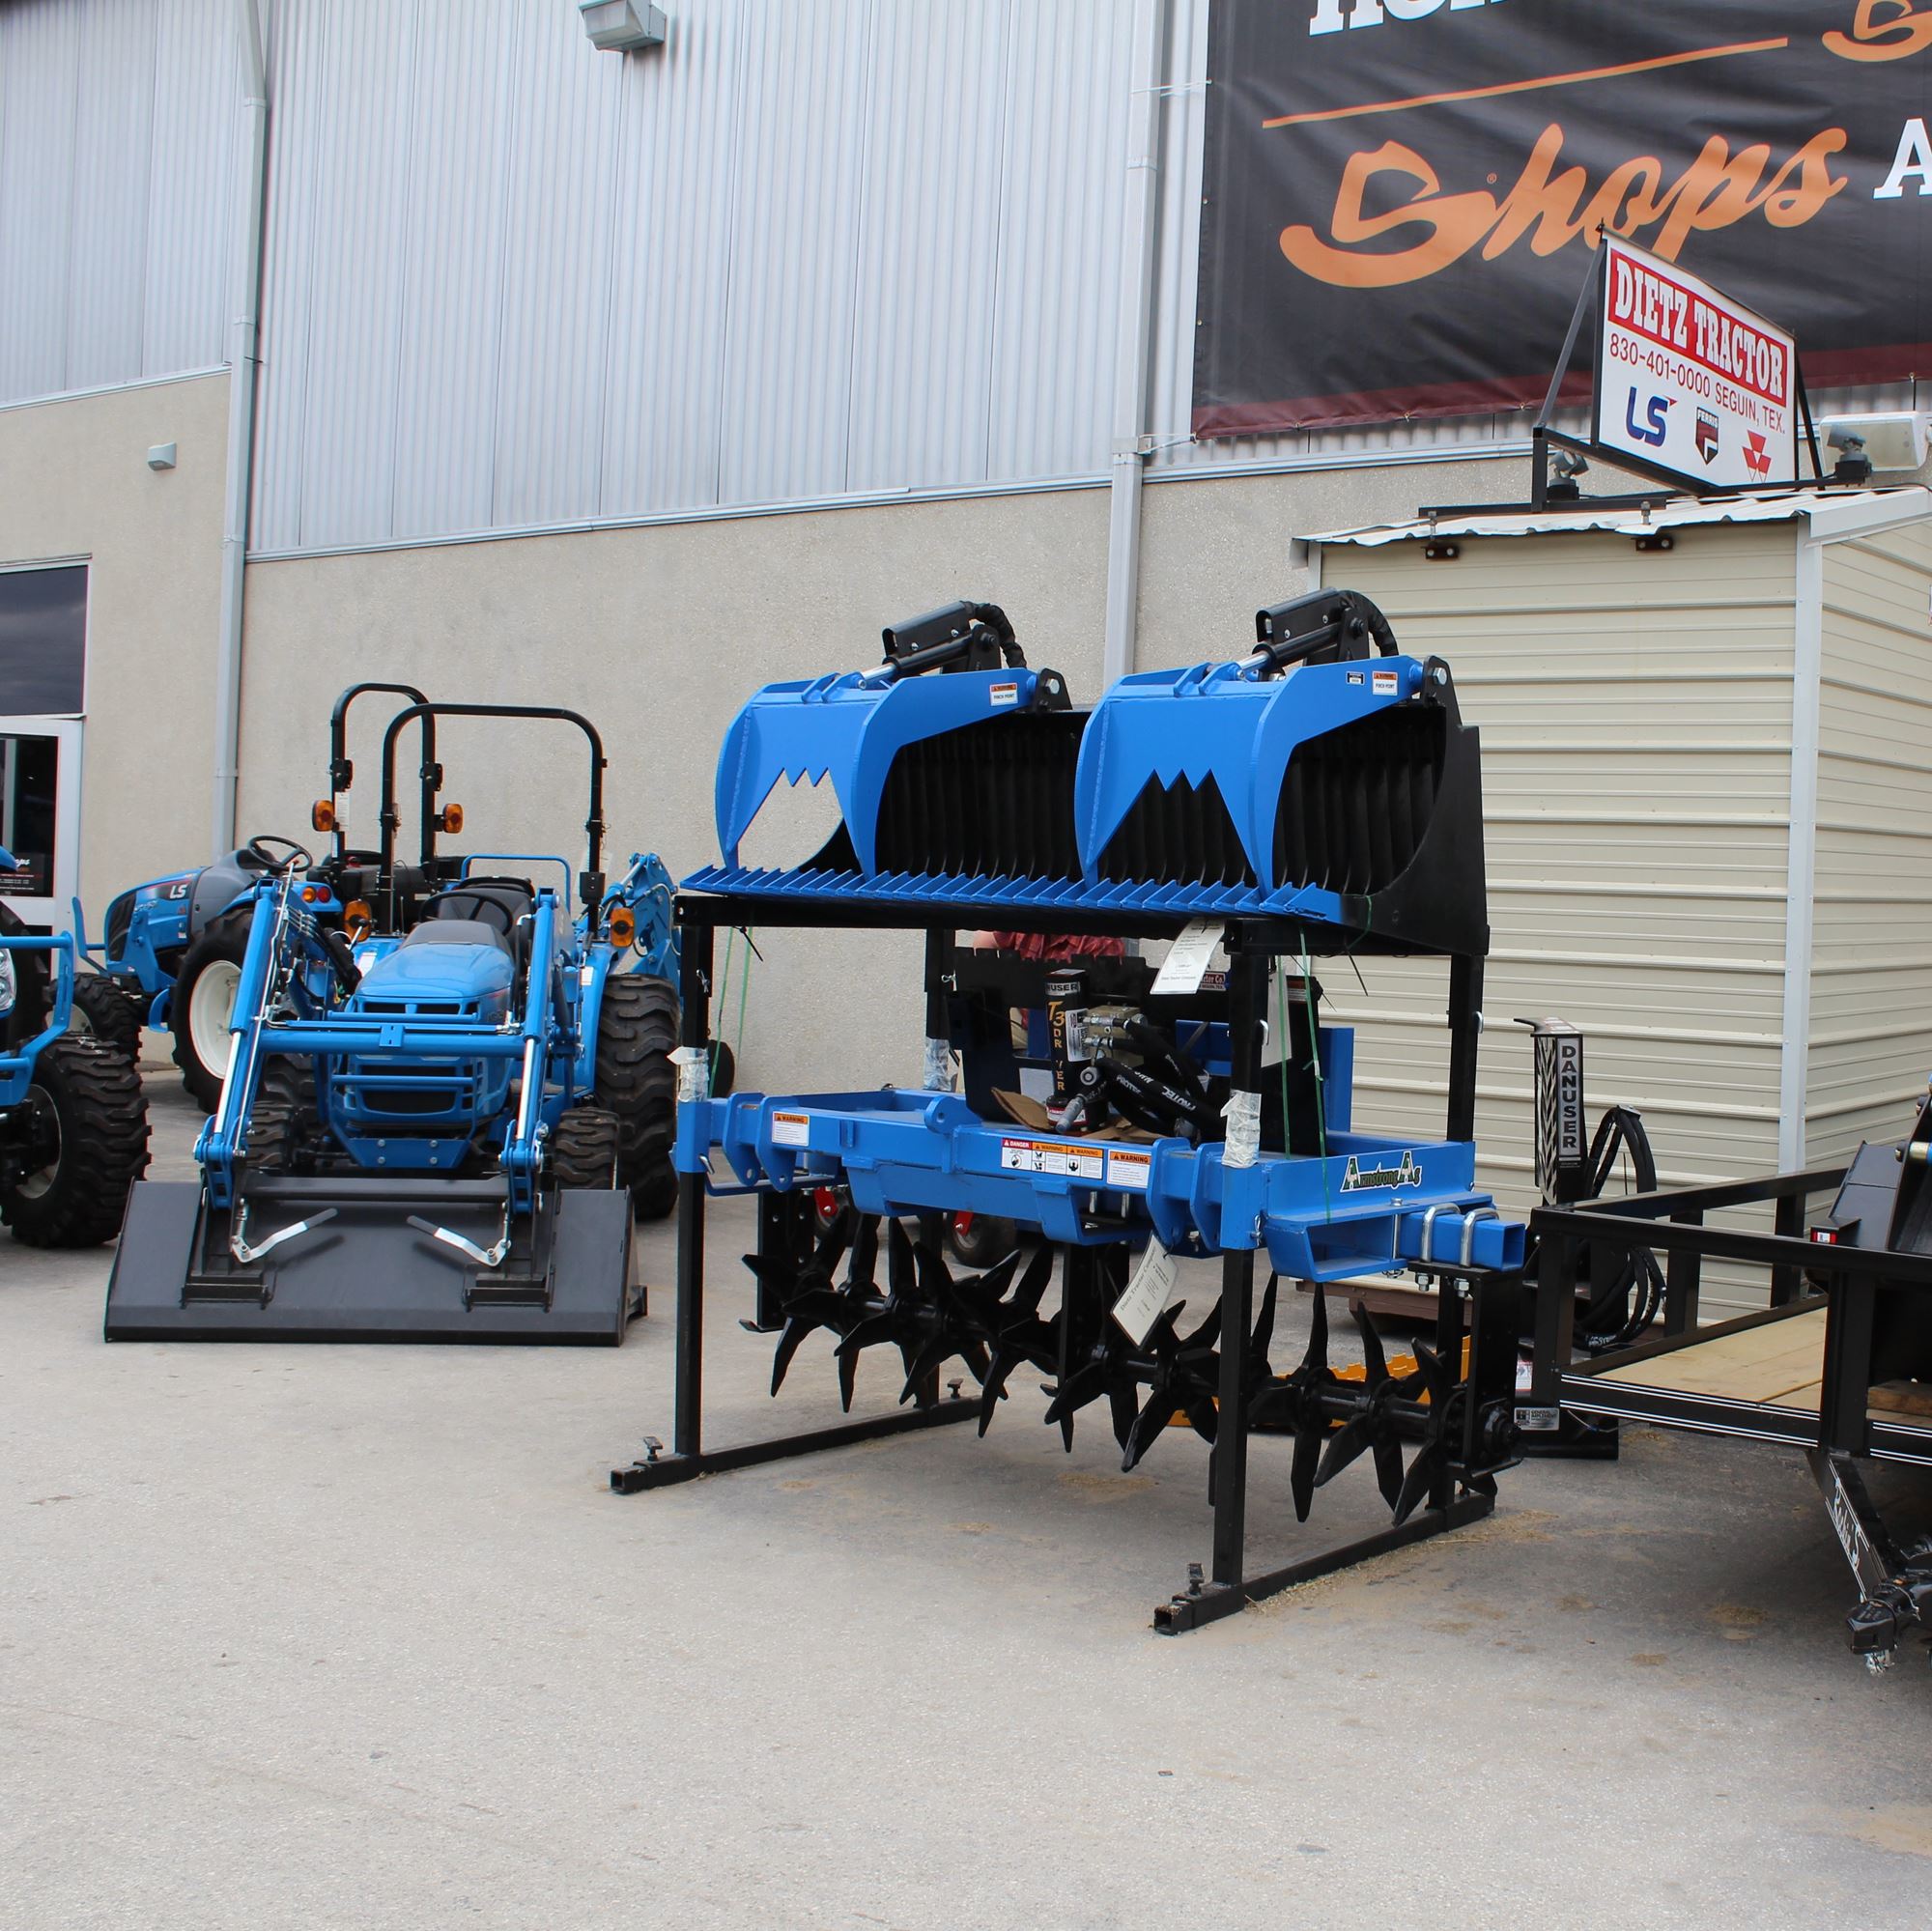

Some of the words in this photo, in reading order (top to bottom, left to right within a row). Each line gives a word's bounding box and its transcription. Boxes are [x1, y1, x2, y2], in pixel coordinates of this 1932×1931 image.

[1279, 124, 1847, 288] Shops
[1614, 257, 1688, 349] DIETZ
[1693, 299, 1783, 401] TRACTOR
[1609, 332, 1711, 398] 830-401-0000
[1715, 383, 1760, 427] SEGUIN,
[1762, 406, 1785, 434] TEX.
[1626, 385, 1669, 447] LS
[169, 884, 188, 899] LS
[1561, 1045, 1577, 1150] DANUSER
[1009, 1140, 1030, 1149] DANGER
[1040, 1144, 1064, 1152] WARNING
[1120, 1153, 1149, 1163] WARNING
